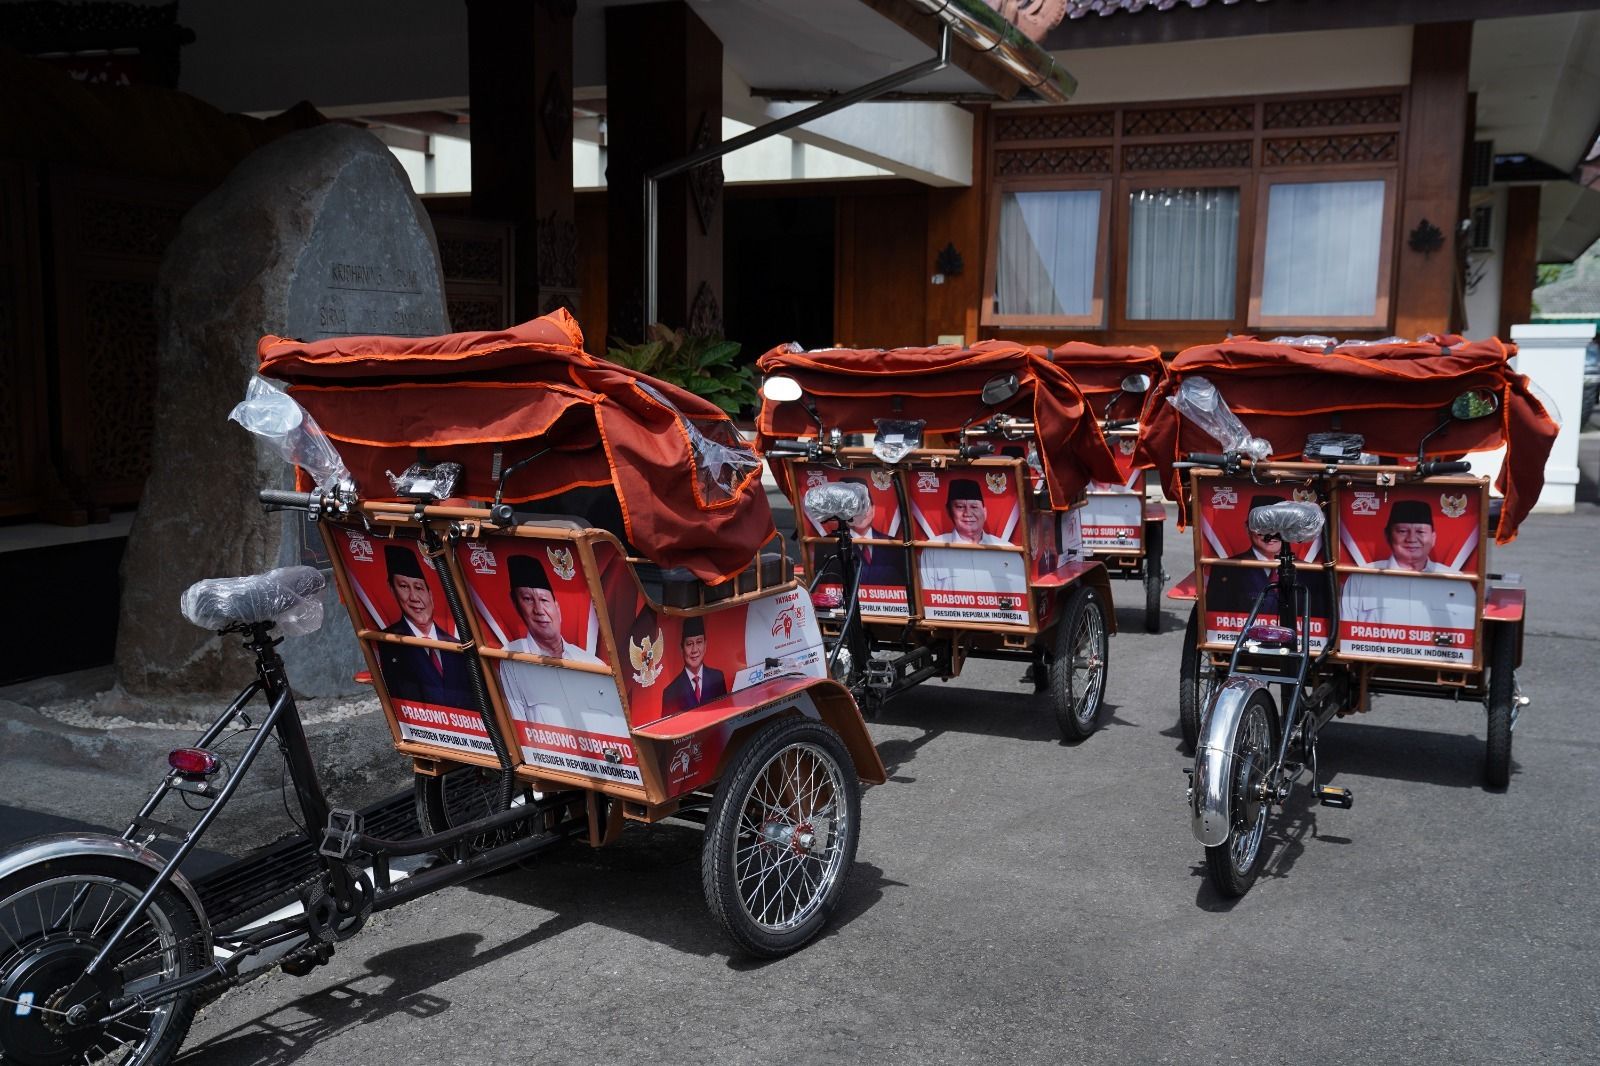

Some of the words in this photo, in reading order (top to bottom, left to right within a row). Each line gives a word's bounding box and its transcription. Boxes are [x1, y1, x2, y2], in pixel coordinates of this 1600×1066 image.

[930, 593, 975, 605] PRABOWO
[860, 604, 882, 612] EPUBLIK
[933, 609, 961, 617] PRESIDEN
[962, 611, 990, 619] REPUBLIK
[991, 612, 1023, 620] INDONESIA
[1350, 626, 1406, 640] PRABOWO
[1351, 643, 1385, 653] PRESIDEN
[1387, 646, 1422, 656] REPUBLIK
[1424, 648, 1464, 659] INDONESIA
[401, 704, 449, 725] PRABOWO
[449, 712, 487, 732] SUBIAN
[409, 727, 439, 742] PRESIDEN
[439, 733, 470, 748] REPUBLIK
[469, 739, 495, 752] INDONE
[524, 727, 578, 750] PRABOWO
[532, 752, 565, 767] PRESIDEN
[565, 758, 599, 773] REPUBLIK
[599, 764, 640, 780] INDONESIA
